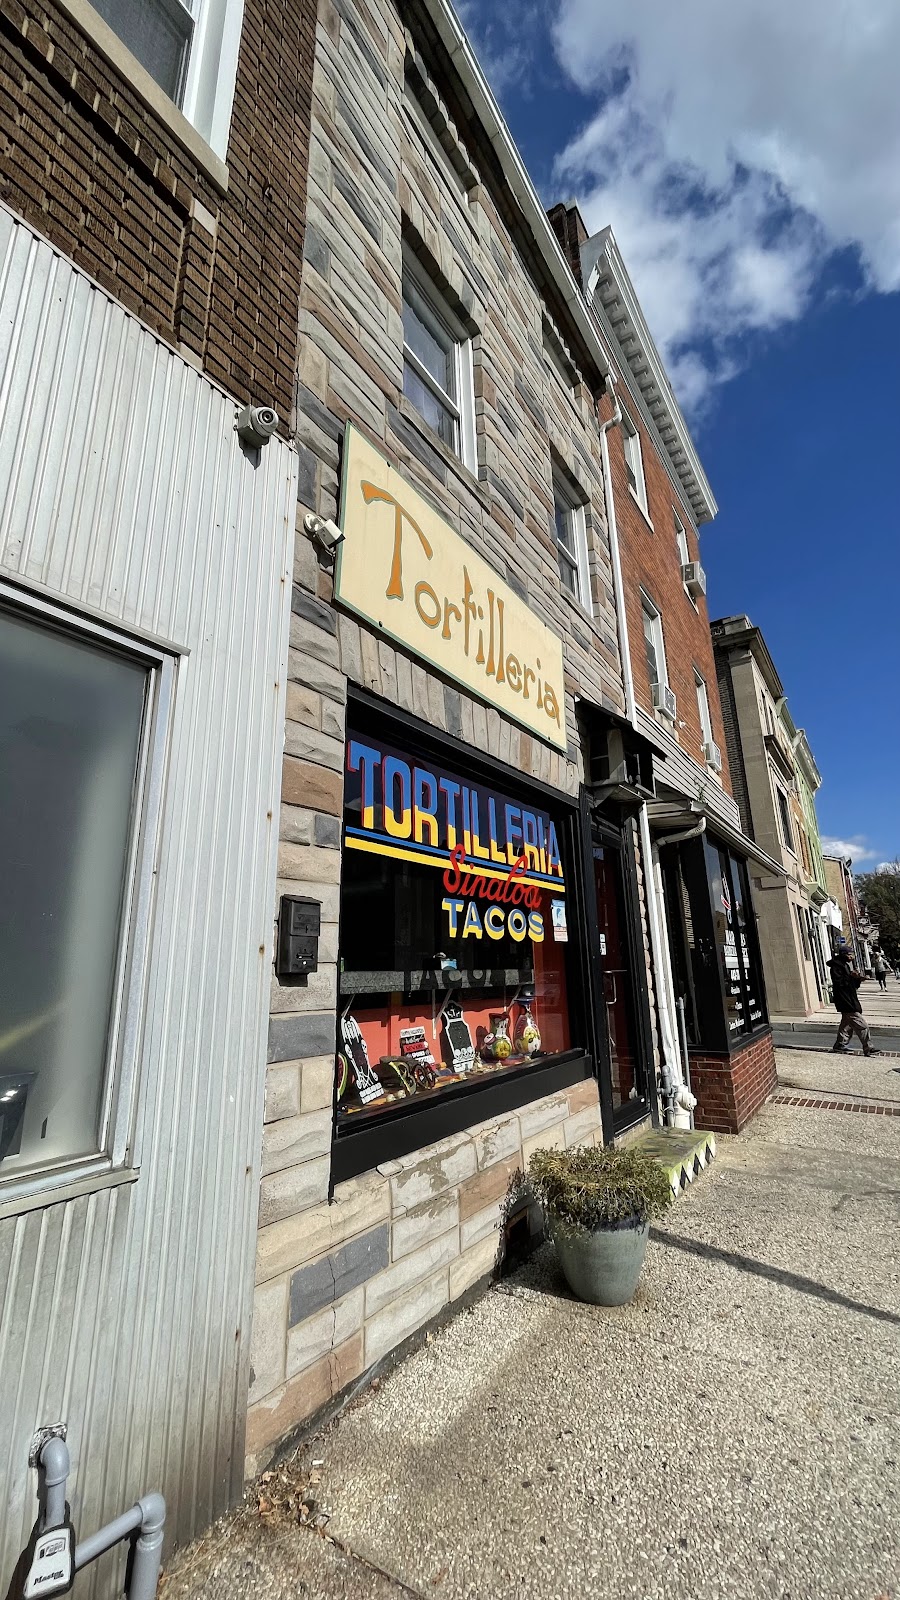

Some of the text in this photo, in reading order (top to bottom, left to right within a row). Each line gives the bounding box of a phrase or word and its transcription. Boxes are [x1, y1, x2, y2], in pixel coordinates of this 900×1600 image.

[361, 480, 560, 729] Tortilleria
[347, 740, 564, 877] TORTILLERIA
[441, 897, 545, 943] TACOS
[443, 843, 542, 908] Sinaloa
